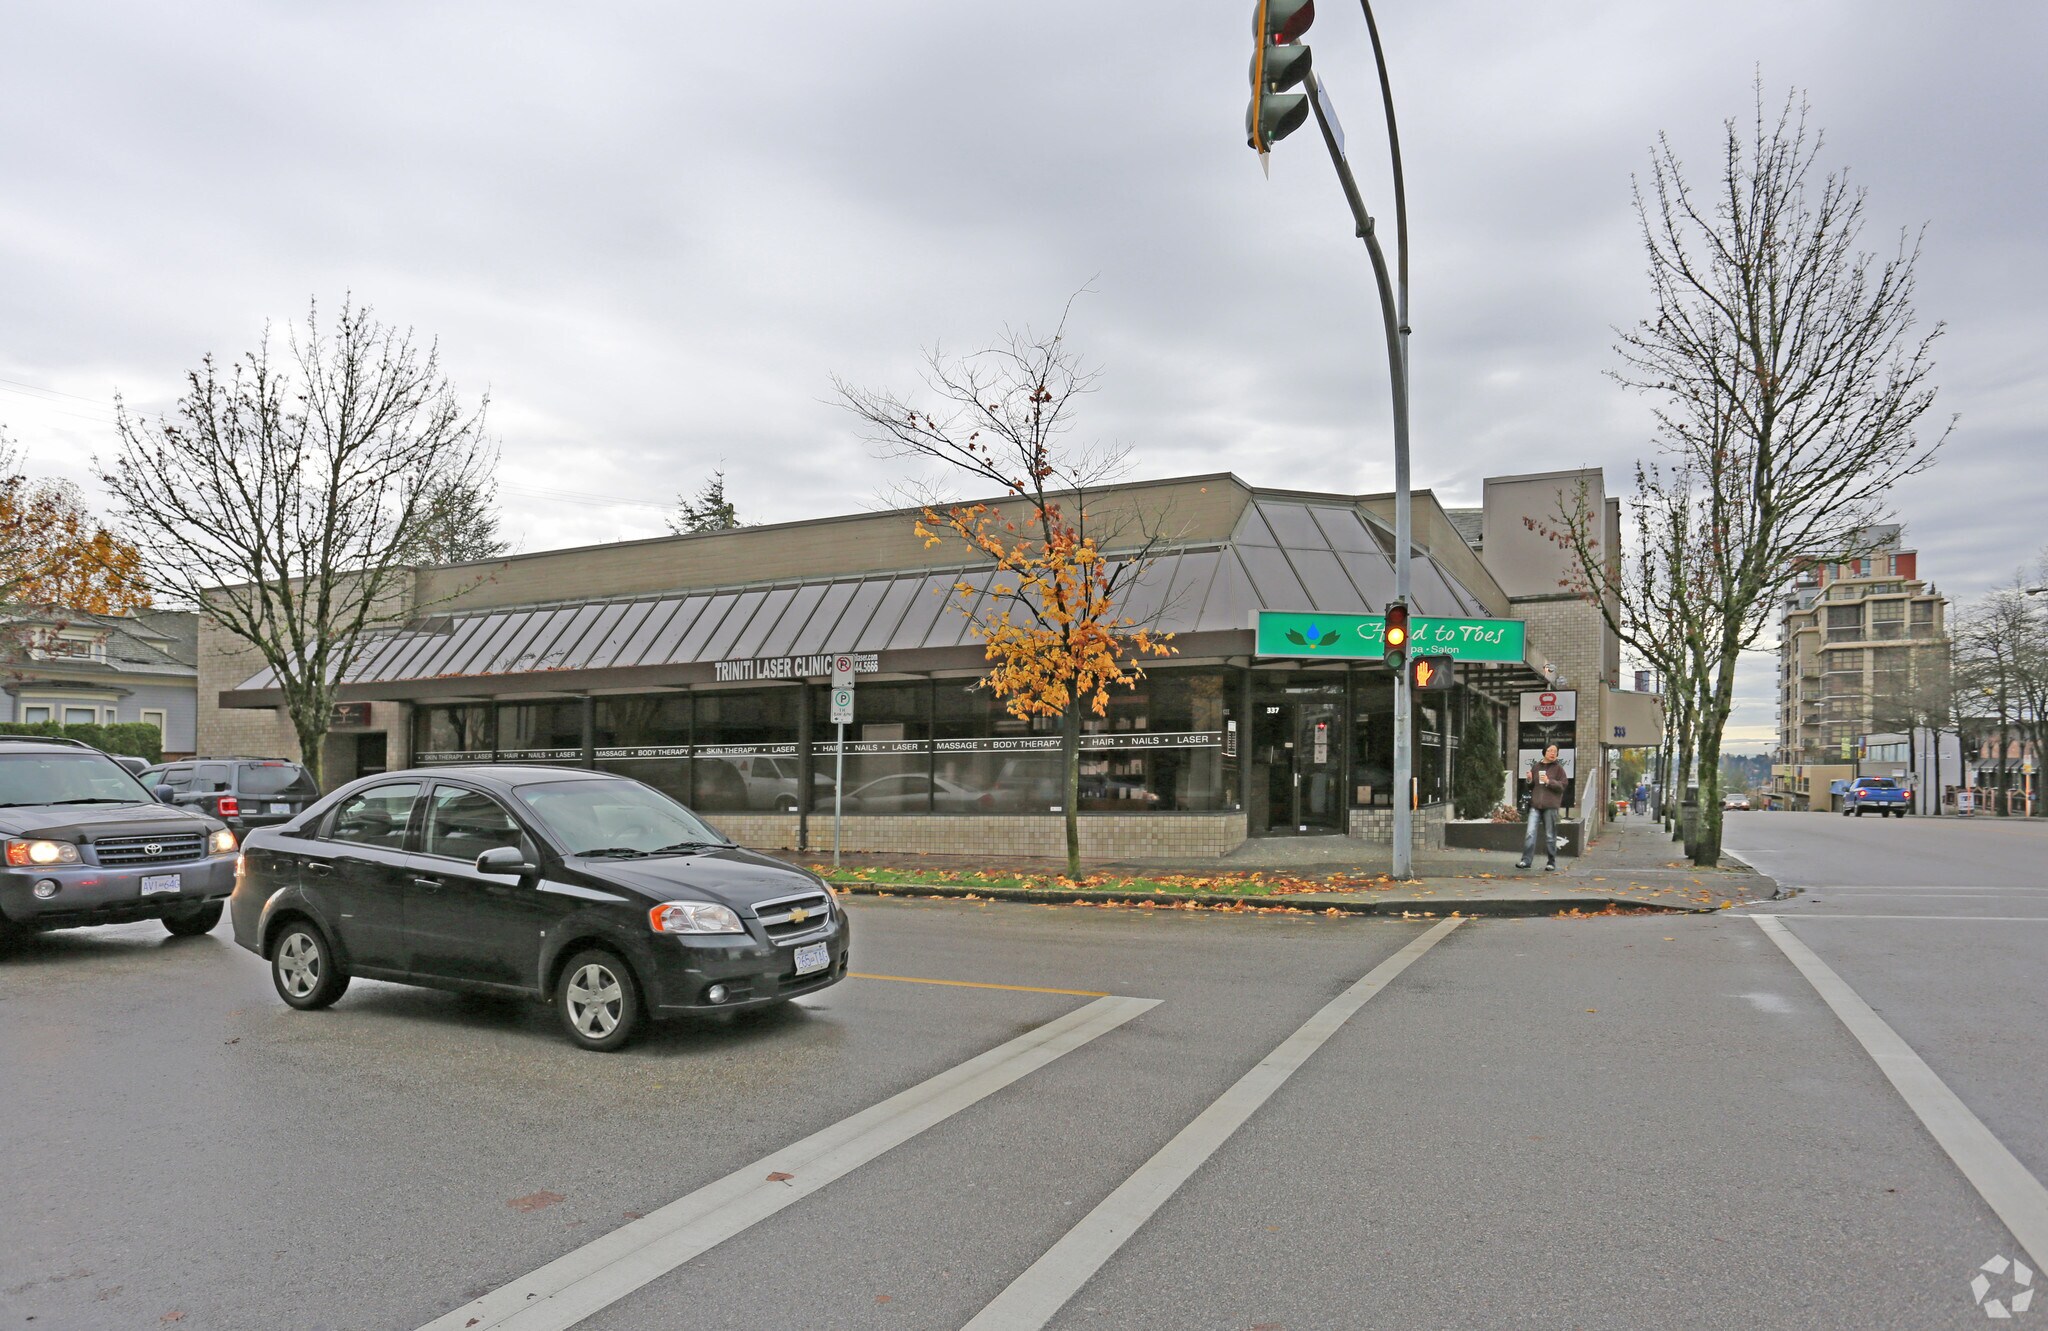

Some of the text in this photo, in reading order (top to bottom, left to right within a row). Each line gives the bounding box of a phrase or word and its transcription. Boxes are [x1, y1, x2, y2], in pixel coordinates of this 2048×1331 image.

[1435, 624, 1456, 641] to
[1459, 625, 1505, 644] Toes
[1410, 645, 1460, 655] pa Salon
[714, 655, 832, 682] TRINITI LASER CLINIC
[1266, 706, 1280, 714] 337
[936, 739, 1061, 750] MASSAGE BODY THERAPY
[1091, 735, 1209, 746] HAIR NAILS LASER
[658, 748, 689, 756] THERAPY
[854, 744, 878, 752] NAILS
[891, 743, 918, 751] LASER
